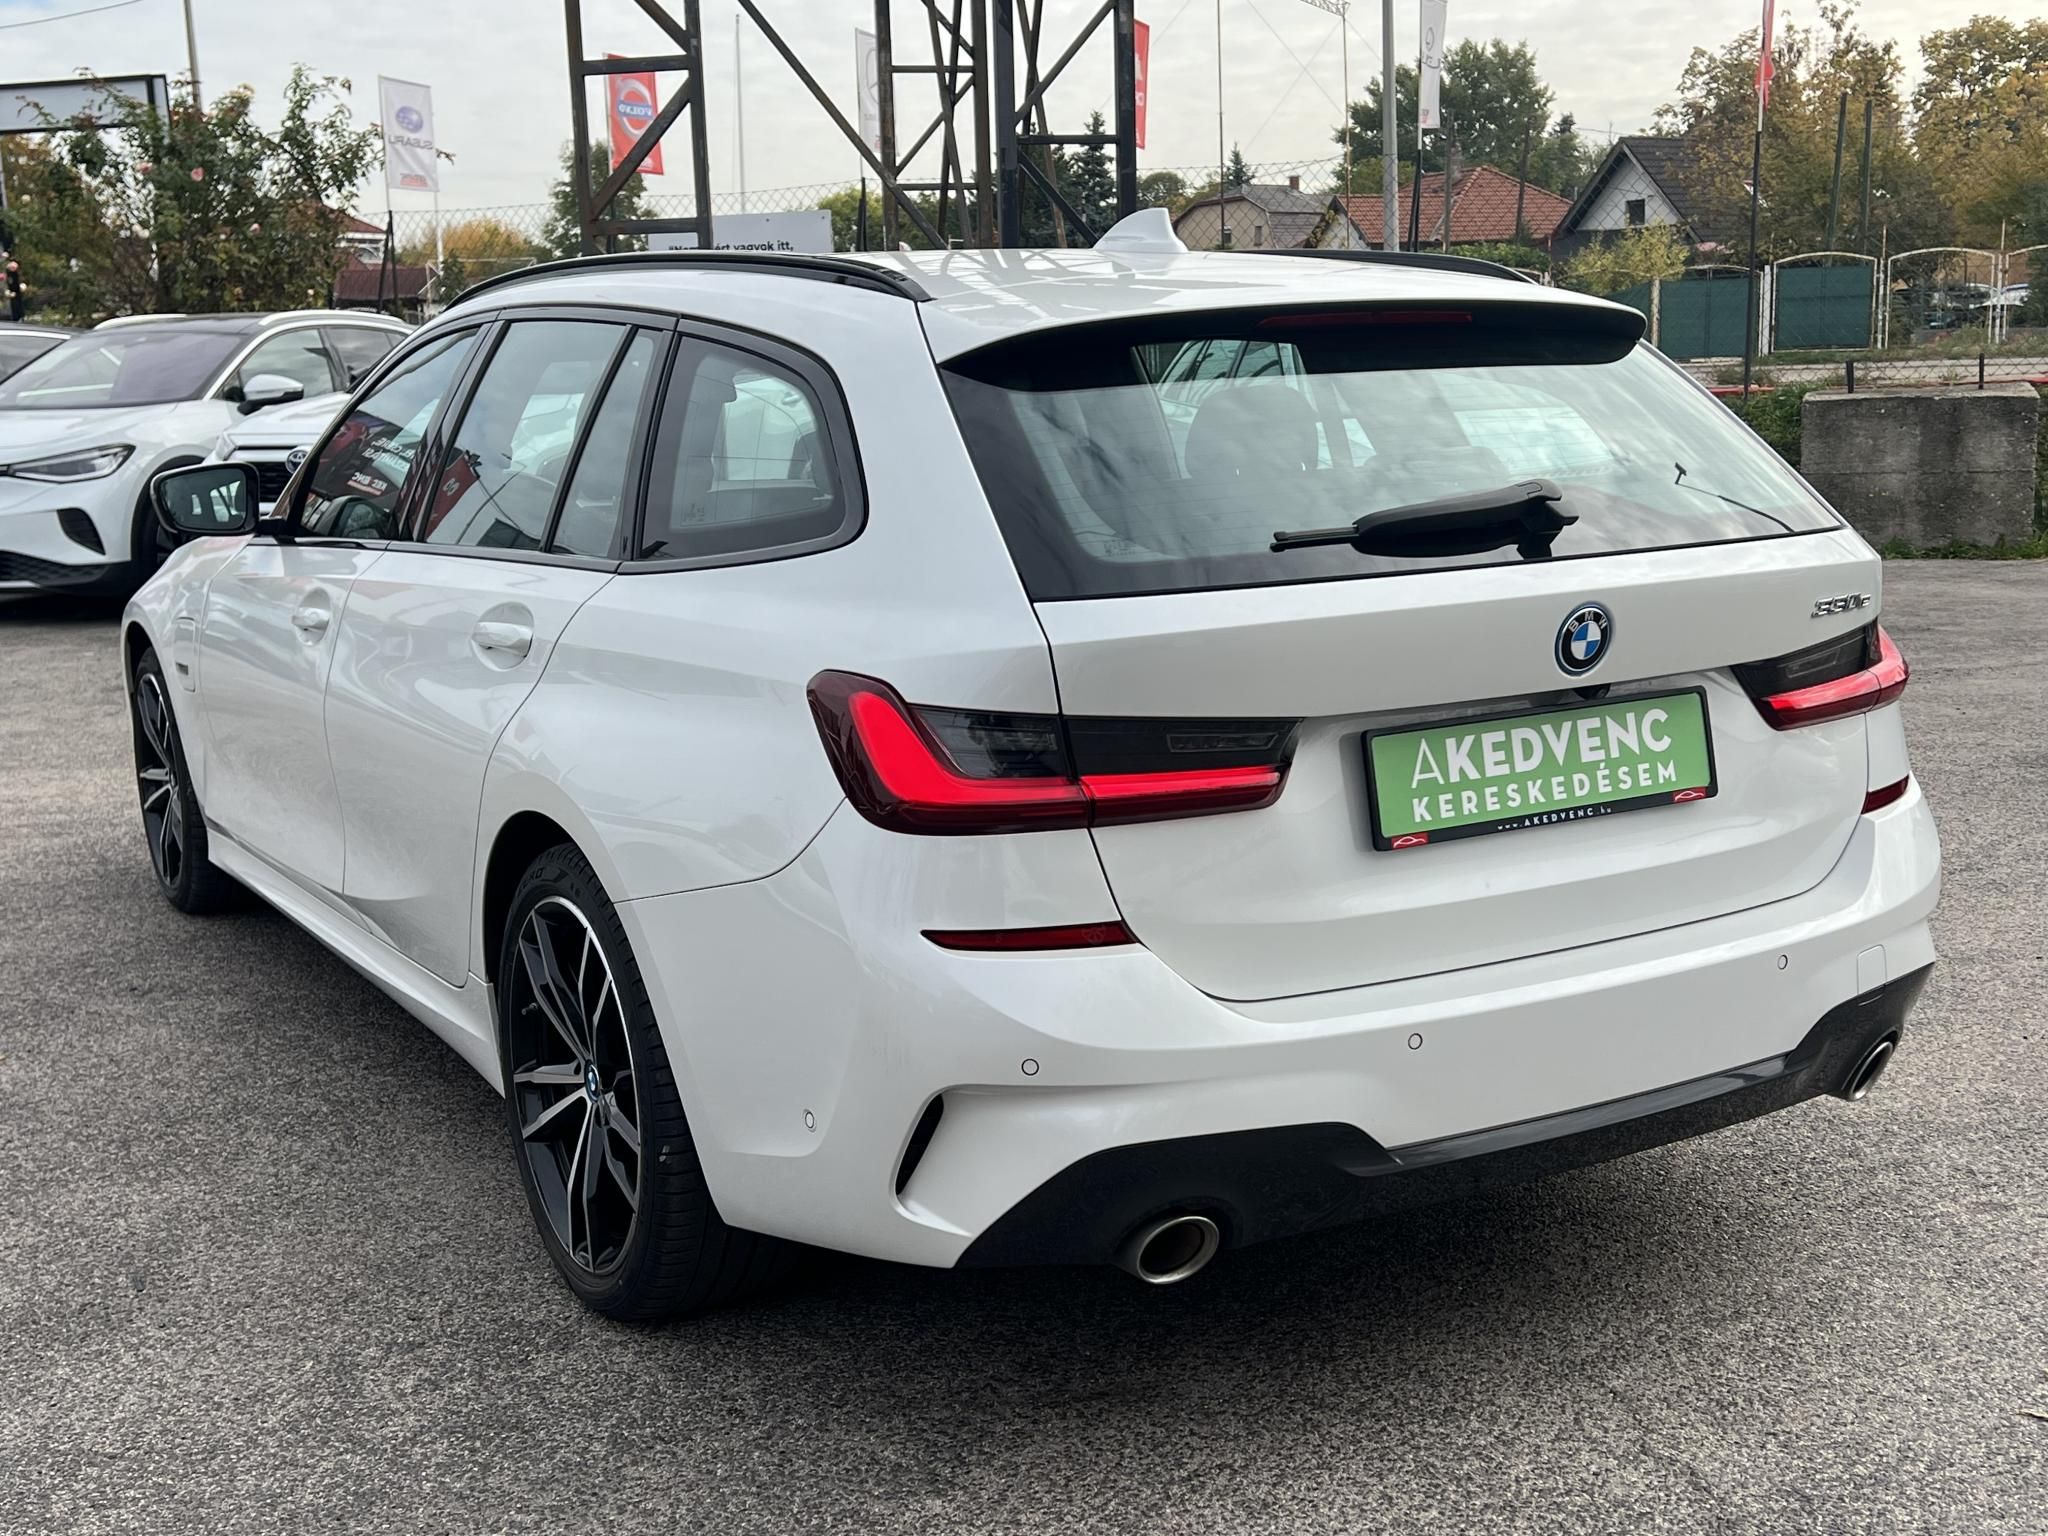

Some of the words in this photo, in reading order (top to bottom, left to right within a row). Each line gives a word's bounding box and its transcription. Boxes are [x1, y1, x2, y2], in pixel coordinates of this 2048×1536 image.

[1569, 610, 1608, 632] BMW
[1411, 708, 1672, 788] AKEDVENC
[1412, 760, 1677, 822] KERESKEDÉSEM
